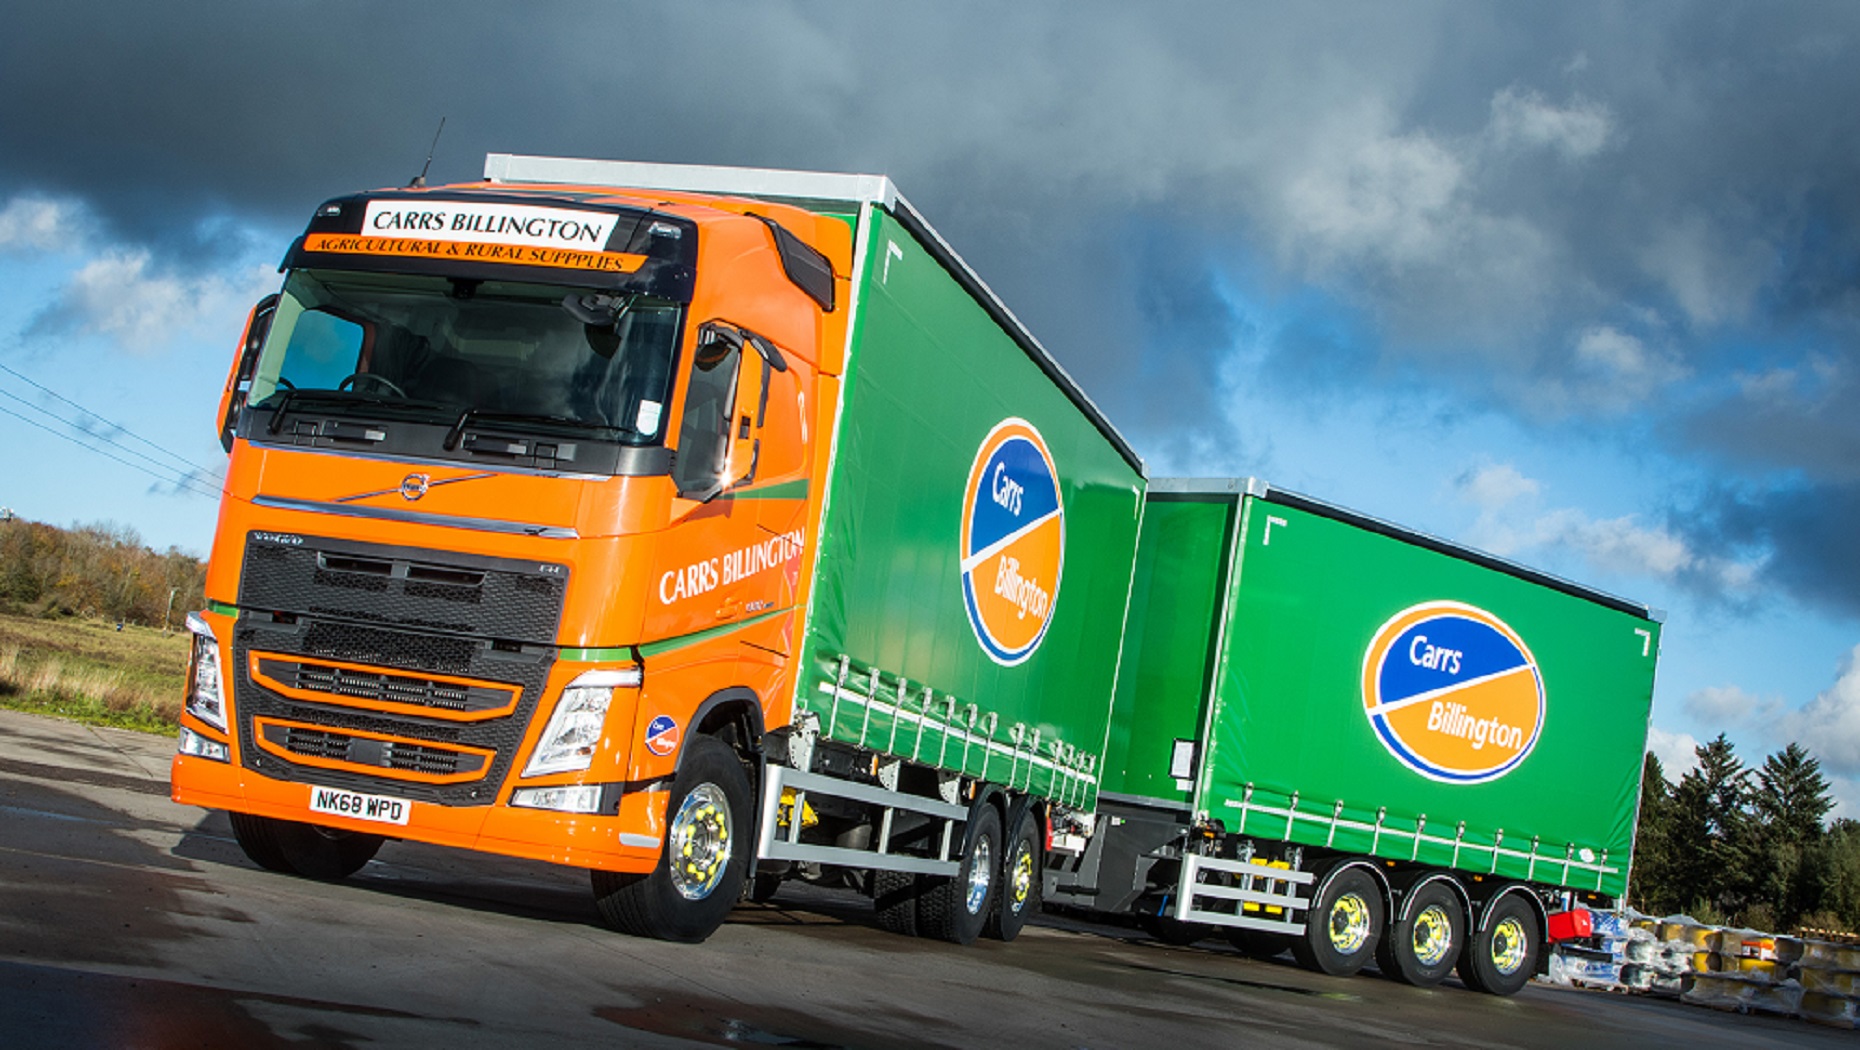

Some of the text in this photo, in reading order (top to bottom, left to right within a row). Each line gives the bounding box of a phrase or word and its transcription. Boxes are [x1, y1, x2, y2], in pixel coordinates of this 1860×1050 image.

[314, 238, 440, 254] AGRICULTURAL
[446, 242, 459, 256] &
[465, 243, 523, 260] RURAL
[373, 210, 602, 243] CARRS BILLINGTON
[992, 461, 1024, 517] Carrs
[659, 527, 805, 605] CARRS BILLINGTON
[994, 555, 1049, 620] Billington
[1409, 635, 1463, 675] Carrs
[1427, 700, 1523, 751] Billington
[317, 789, 403, 821] NK68 WPD
